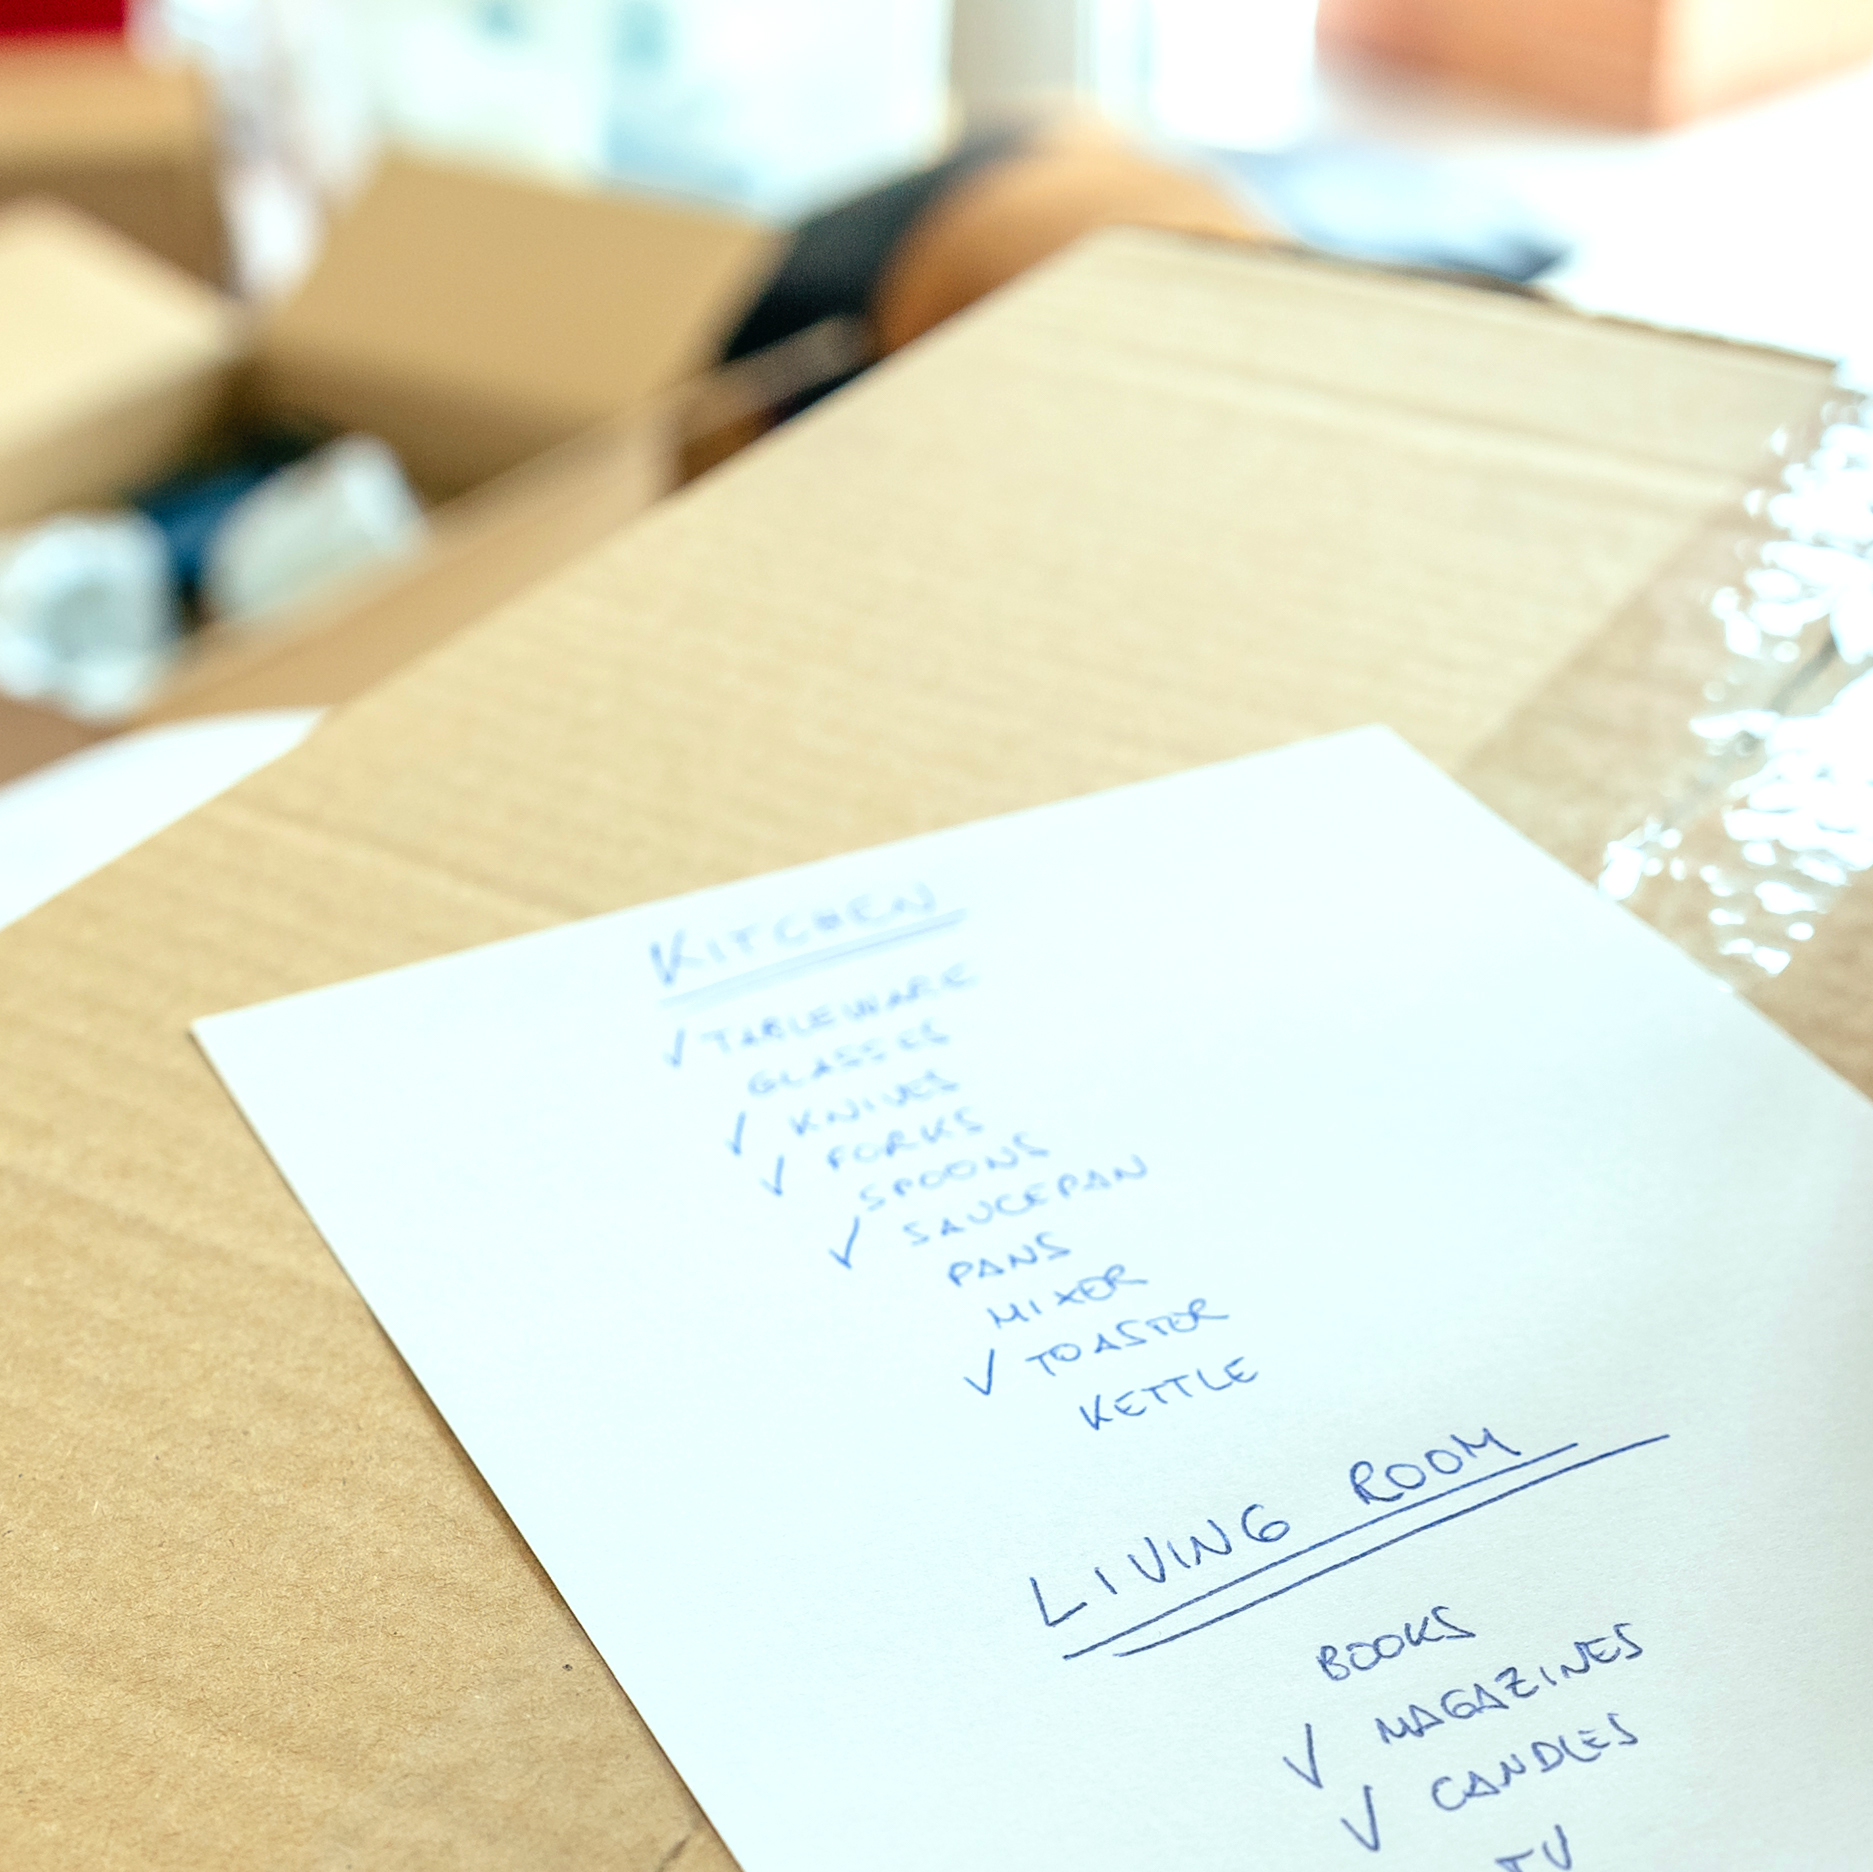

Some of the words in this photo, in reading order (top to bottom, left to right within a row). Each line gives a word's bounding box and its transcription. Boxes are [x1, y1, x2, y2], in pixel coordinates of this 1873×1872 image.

[649, 884, 936, 988] KITCHEN
[702, 965, 973, 1052] TABLEWARE
[747, 1020, 950, 1097] GLASSES
[789, 1069, 959, 1137] KNIVES
[826, 1109, 983, 1171] FORKS
[859, 1133, 1050, 1211] SPOONS
[902, 1156, 1147, 1246] SAUCEPAN
[947, 1233, 1071, 1287] PANS
[987, 1264, 1148, 1328] MIXER
[1026, 1298, 1229, 1376] TOASTER
[1079, 1357, 1258, 1431] KETTLE
[1029, 1503, 1290, 1627] LIVING
[1349, 1427, 1522, 1505] ROOM
[1317, 1605, 1476, 1681] BOOKS
[1375, 1622, 1643, 1744] MAGAZINES
[1431, 1713, 1638, 1812] CANDLES
